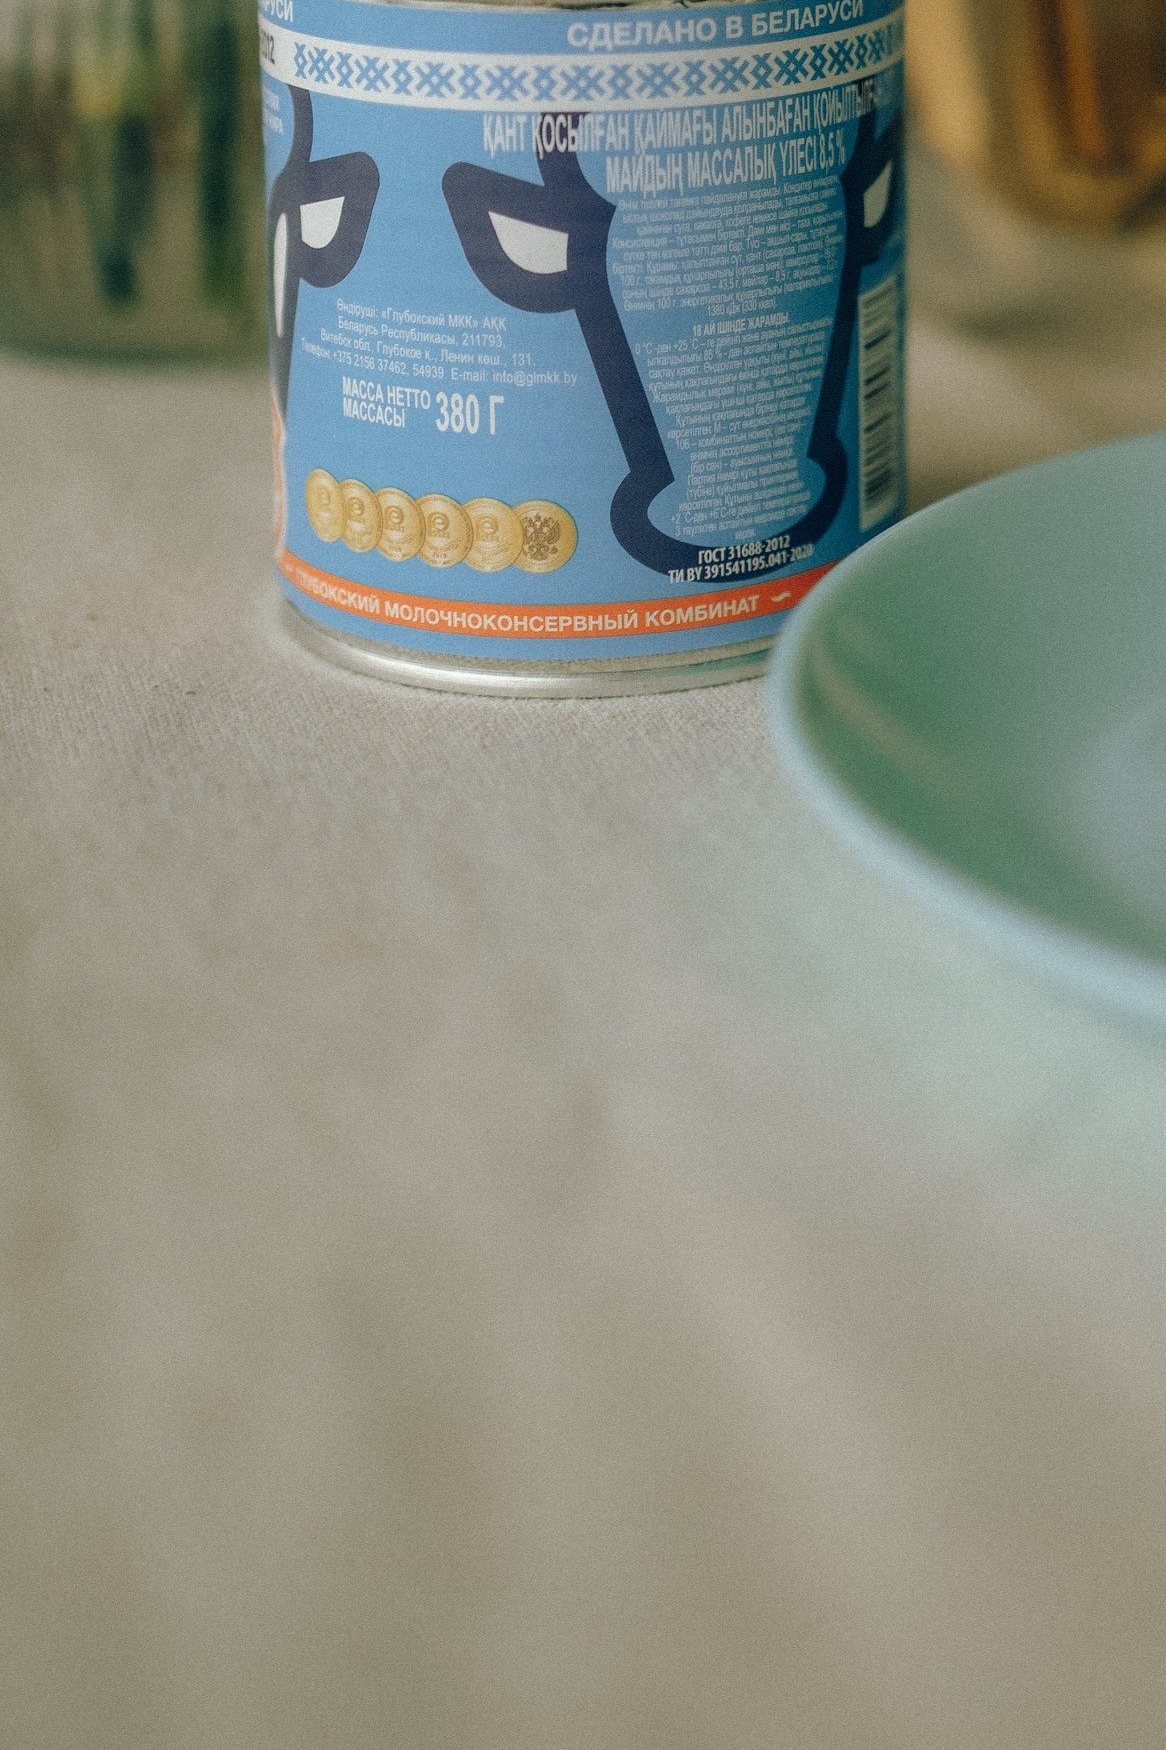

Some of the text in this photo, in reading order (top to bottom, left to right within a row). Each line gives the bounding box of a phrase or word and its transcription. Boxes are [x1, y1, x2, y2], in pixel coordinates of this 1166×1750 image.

[567, 18, 717, 51] СДЕЛАНО
[726, 16, 743, 39] В
[483, 113, 527, 157] ҚАНТ
[532, 112, 629, 159] ҚОСЫЛҒАН
[634, 107, 718, 155] ҚАЙМАҒЫ
[721, 95, 810, 140] АЛЫНБАҒАН
[606, 150, 684, 200] МАЙДЫҢ
[688, 143, 776, 187] МАССАЛЫҚ
[820, 131, 834, 175] 8,5
[338, 316, 378, 337] Беларусь
[483, 316, 507, 332] АҚҚ
[332, 350, 352, 365] +375
[353, 354, 375, 370] 2156
[377, 358, 410, 377] 37462,
[451, 367, 489, 382] E-mail:
[376, 340, 422, 358] Глубокое
[440, 349, 475, 364] Ленин
[342, 376, 431, 410] МАССА НЕТТО
[343, 398, 405, 428] МАССАСЫ
[435, 391, 504, 435] 380 Г
[698, 548, 727, 565] ГОСТ
[728, 535, 791, 561] 31688-2012
[668, 568, 686, 584] ТИ
[384, 600, 639, 633] МОЛОЧНОКОНСЕРВНЫЙ
[645, 595, 760, 629] КОМБИНАТ
